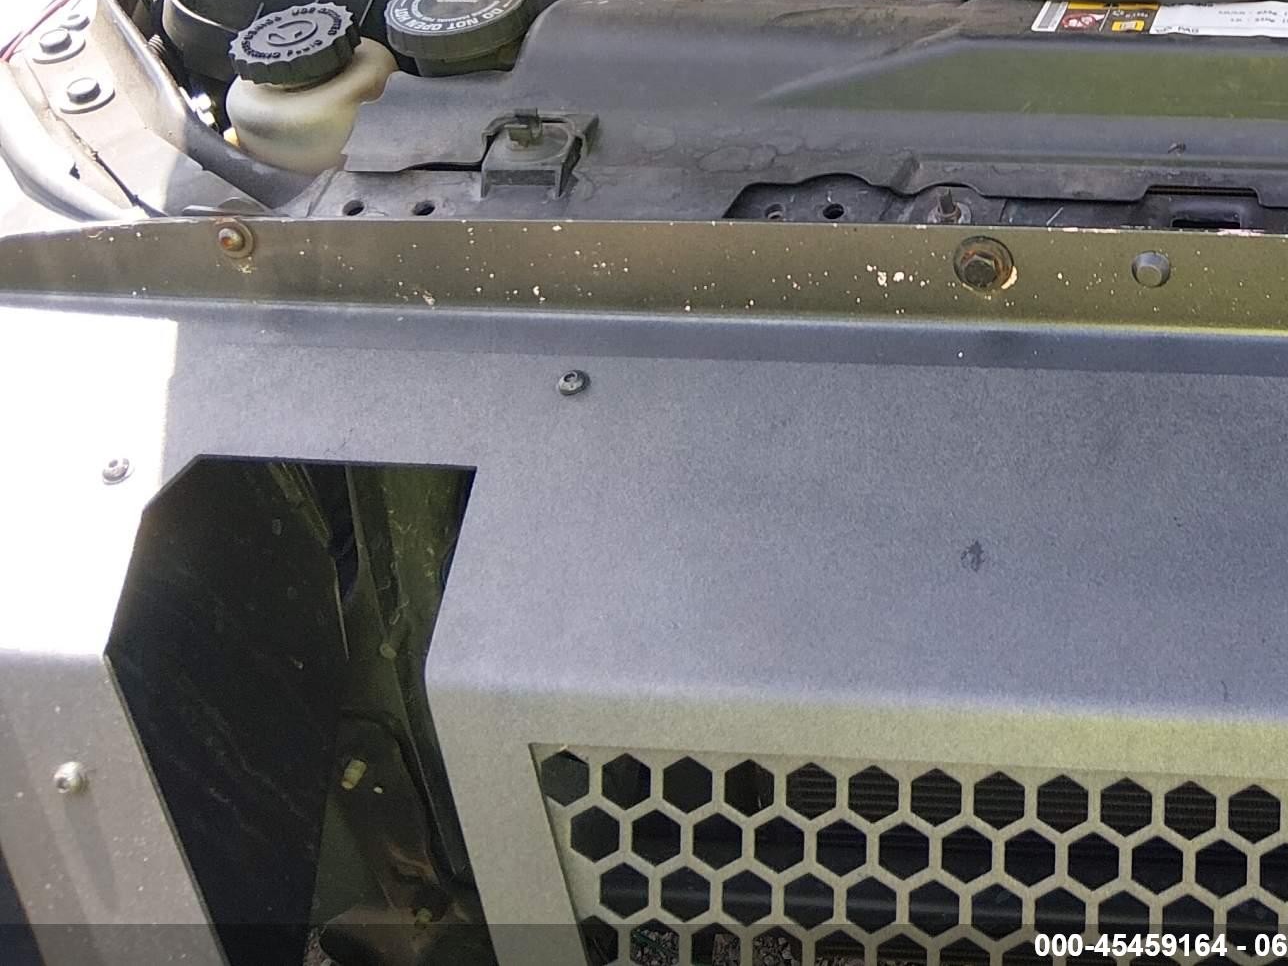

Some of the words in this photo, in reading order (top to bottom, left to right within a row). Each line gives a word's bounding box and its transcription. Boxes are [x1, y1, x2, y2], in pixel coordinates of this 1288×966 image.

[482, 8, 505, 20] DO
[405, 19, 443, 31] OPEN
[447, 17, 480, 31] NOT
